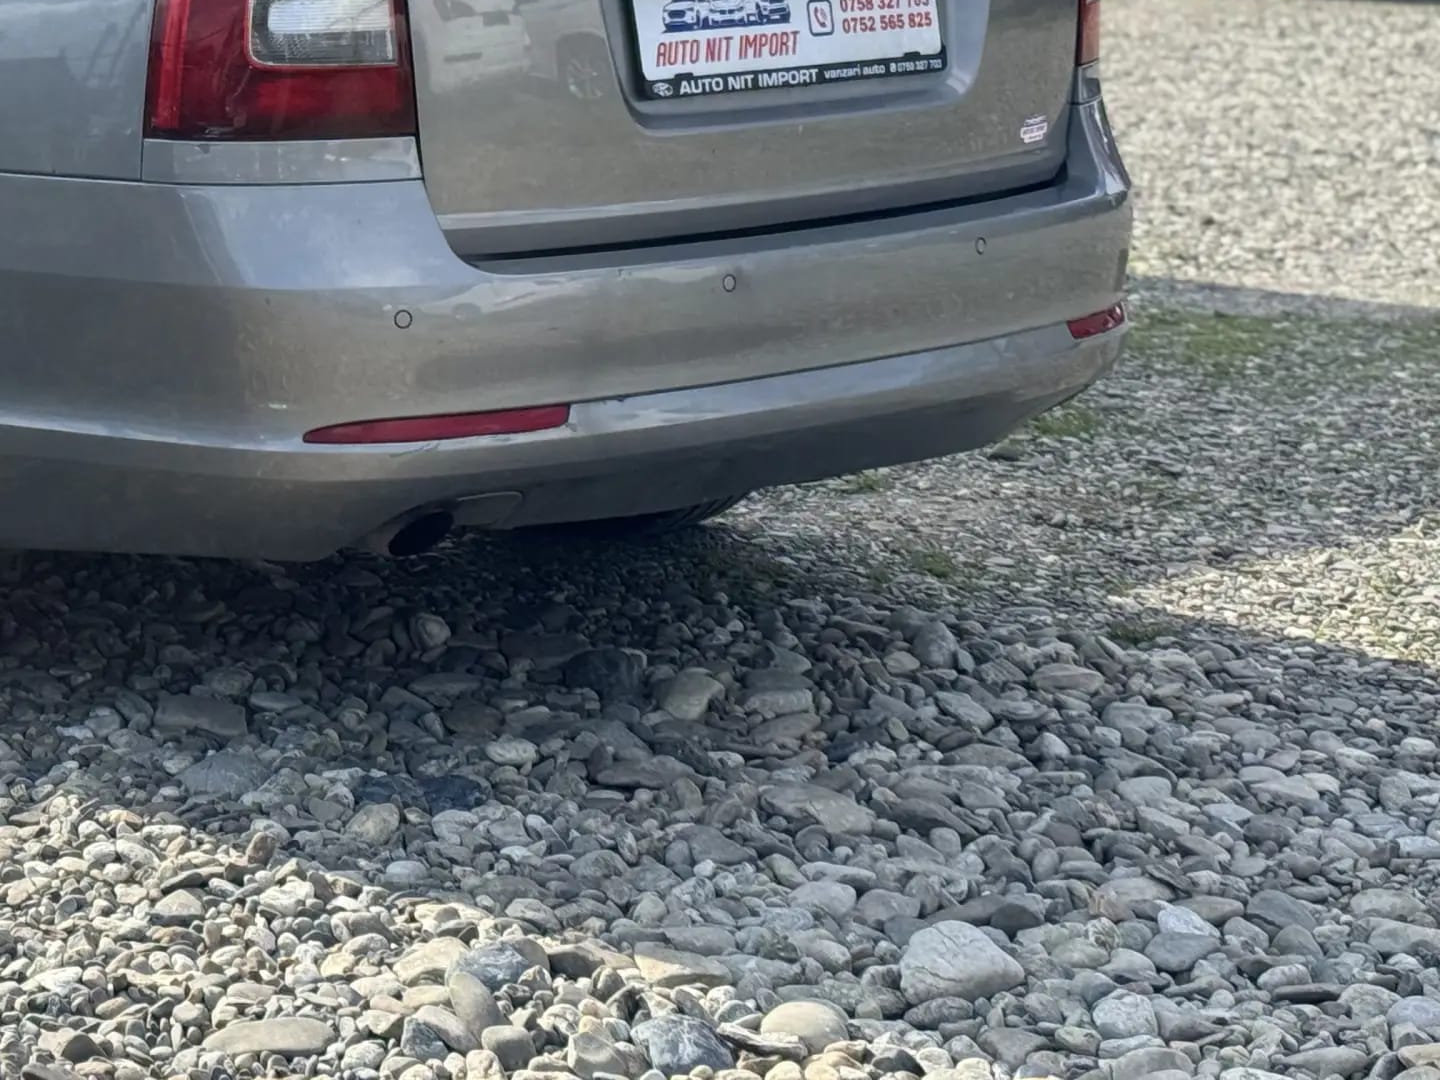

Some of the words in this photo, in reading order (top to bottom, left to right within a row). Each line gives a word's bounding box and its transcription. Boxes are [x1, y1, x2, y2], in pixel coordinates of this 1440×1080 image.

[842, 16, 876, 34] 0752
[879, 13, 905, 30] 565
[908, 11, 932, 29] 825
[656, 39, 701, 67] AUTO
[705, 36, 734, 63] NIT
[739, 30, 800, 60] IMPORT
[679, 77, 724, 96] AUTO
[728, 74, 754, 90] NIT
[758, 68, 819, 88] IMPORT
[823, 63, 861, 79] vanzari
[862, 64, 886, 75] auto
